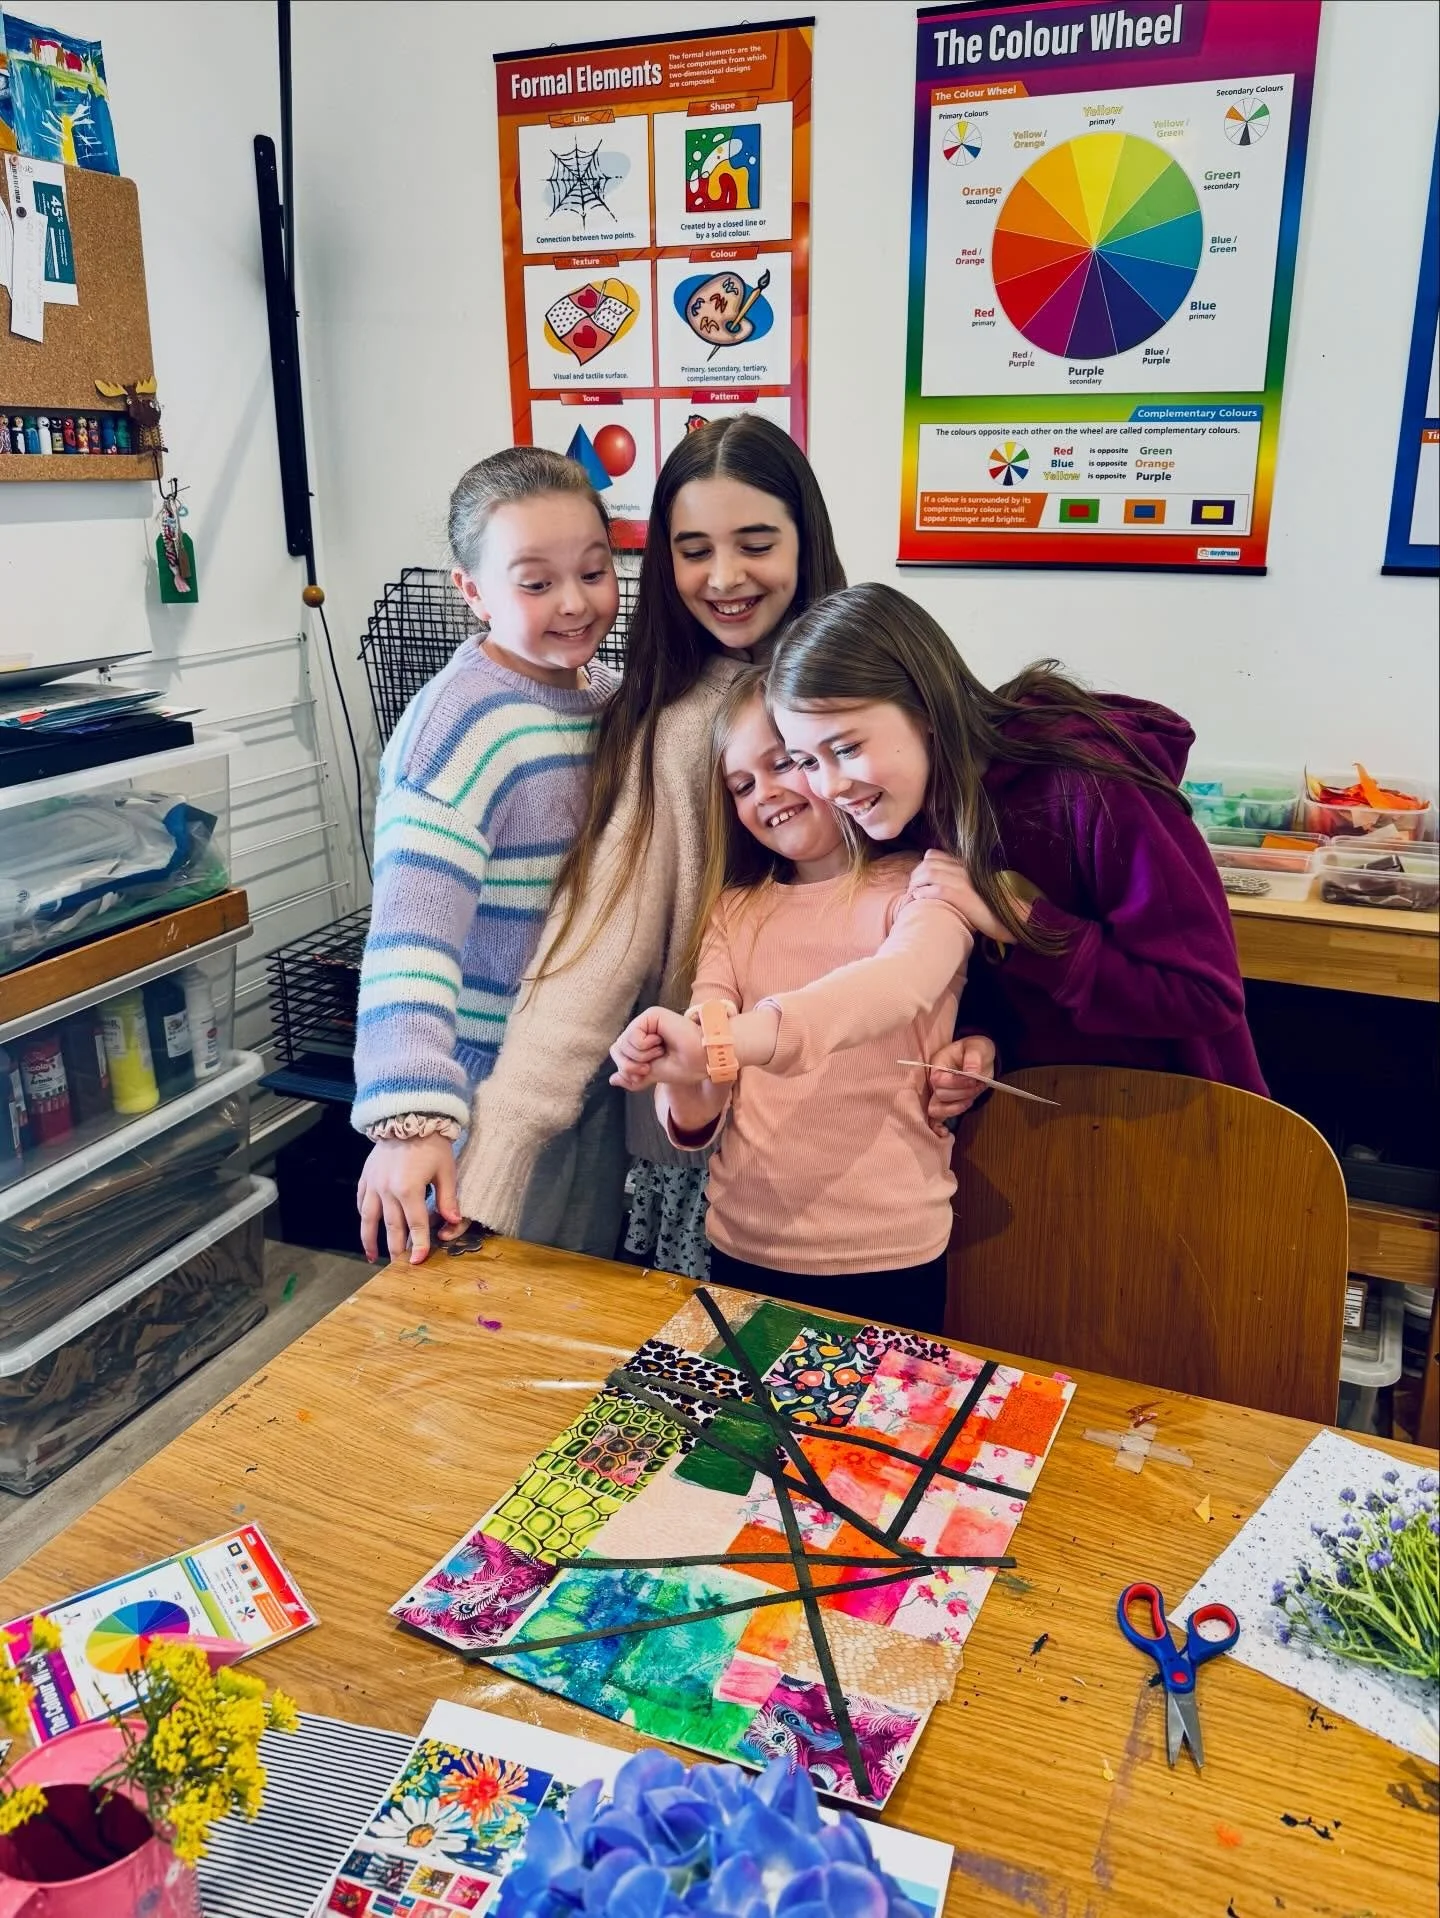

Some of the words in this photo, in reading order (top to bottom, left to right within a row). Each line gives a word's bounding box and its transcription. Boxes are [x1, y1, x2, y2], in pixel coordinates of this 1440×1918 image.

[934, 29, 982, 66] The
[989, 20, 1084, 62] Colour
[1090, 4, 1183, 52] Wheel
[706, 47, 736, 57] elements
[687, 58, 727, 68] components
[669, 68, 724, 79] two-dimensional
[725, 65, 751, 73] designs
[512, 66, 572, 100] Formal
[576, 60, 662, 94] Elements
[935, 92, 951, 101] The
[953, 89, 985, 99] Colour
[987, 85, 1016, 96] Wheel
[1217, 87, 1254, 96] Secondary
[710, 101, 736, 113] Shape
[1083, 105, 1124, 117] Yellow
[939, 112, 963, 120] Primary
[1089, 118, 1115, 127] primary
[1153, 120, 1184, 129] Yellow
[1013, 131, 1042, 139] Yellow
[1156, 130, 1184, 138] Green
[1205, 171, 1241, 181] Green
[1204, 182, 1240, 190] secondary
[962, 187, 1002, 197] Orange
[680, 222, 706, 230] Created
[536, 235, 570, 244] Connection
[696, 232, 704, 240] by
[710, 250, 737, 258] Colour
[956, 257, 984, 266] Orange
[1190, 301, 1216, 310] Blue
[974, 308, 994, 317] Red
[1142, 357, 1171, 365] Purple
[1068, 366, 1104, 377] Purple
[687, 374, 735, 383] complementary
[1138, 409, 1216, 419] Complementary
[978, 428, 1010, 437] opposite
[1144, 427, 1206, 435] complementary
[1053, 446, 1073, 455] Red
[1140, 447, 1172, 455] Green
[1051, 459, 1074, 467] Blue
[1135, 460, 1175, 470] Orange
[1043, 471, 1080, 480] Yellow
[1136, 472, 1172, 482] Purple
[40, 1682, 63, 1719] Colour
[50, 1714, 70, 1736] The
